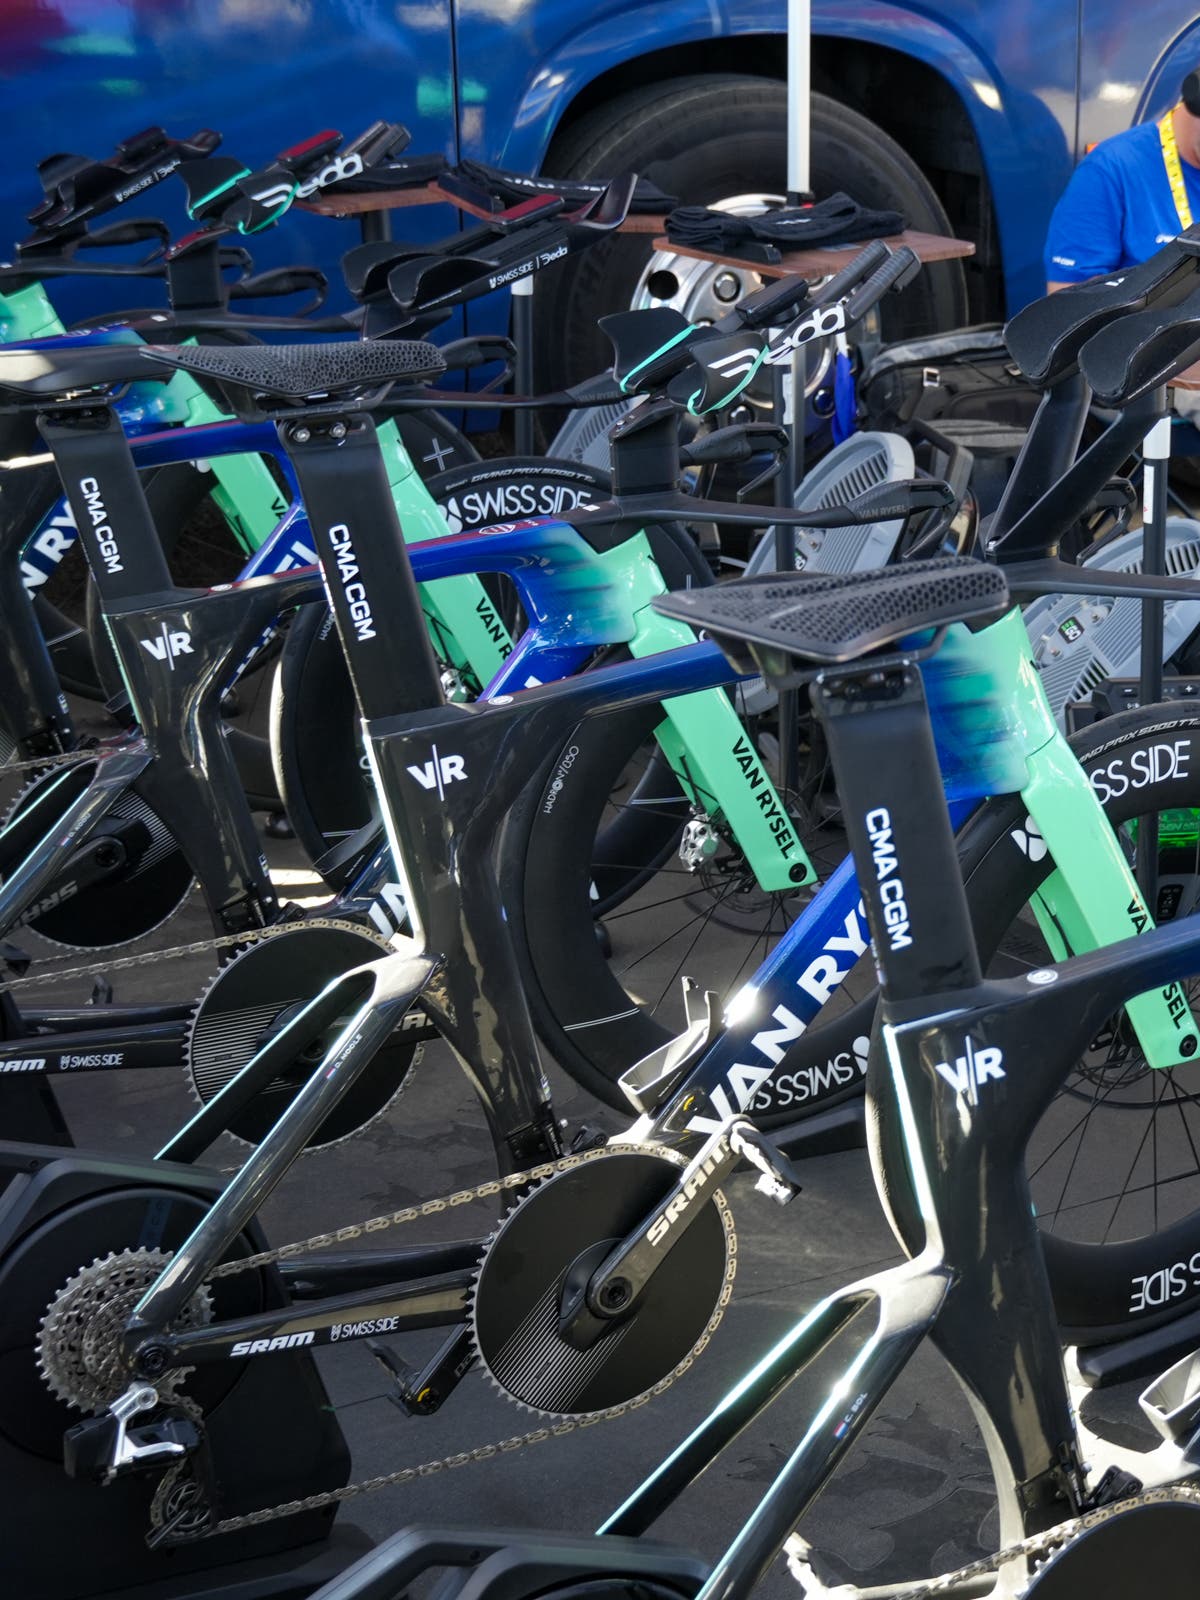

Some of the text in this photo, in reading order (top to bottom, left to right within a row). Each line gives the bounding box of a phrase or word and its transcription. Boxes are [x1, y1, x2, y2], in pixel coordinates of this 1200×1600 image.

[496, 246, 568, 285] SWISS SIDE Deda
[512, 467, 541, 476] PRIX
[80, 477, 124, 574] CMA CGM
[463, 485, 592, 524] SWISS SIDE
[328, 524, 377, 641] CMA CGM
[474, 597, 505, 643] VAN
[1104, 731, 1139, 751] PRIX
[1131, 740, 1191, 788] SIDE
[732, 735, 797, 860] VAN RYSEL
[866, 807, 913, 950] CMA CGM
[1126, 894, 1153, 936] VA
[1162, 981, 1188, 1030] SEL
[70, 1054, 102, 1068] SWISS
[102, 1053, 124, 1067] SIDE
[685, 1004, 808, 1135] VAN
[776, 1052, 854, 1106] SWISS
[1129, 1262, 1188, 1313] SIDE
[230, 1316, 400, 1358] SRAM SWISS SIDE
